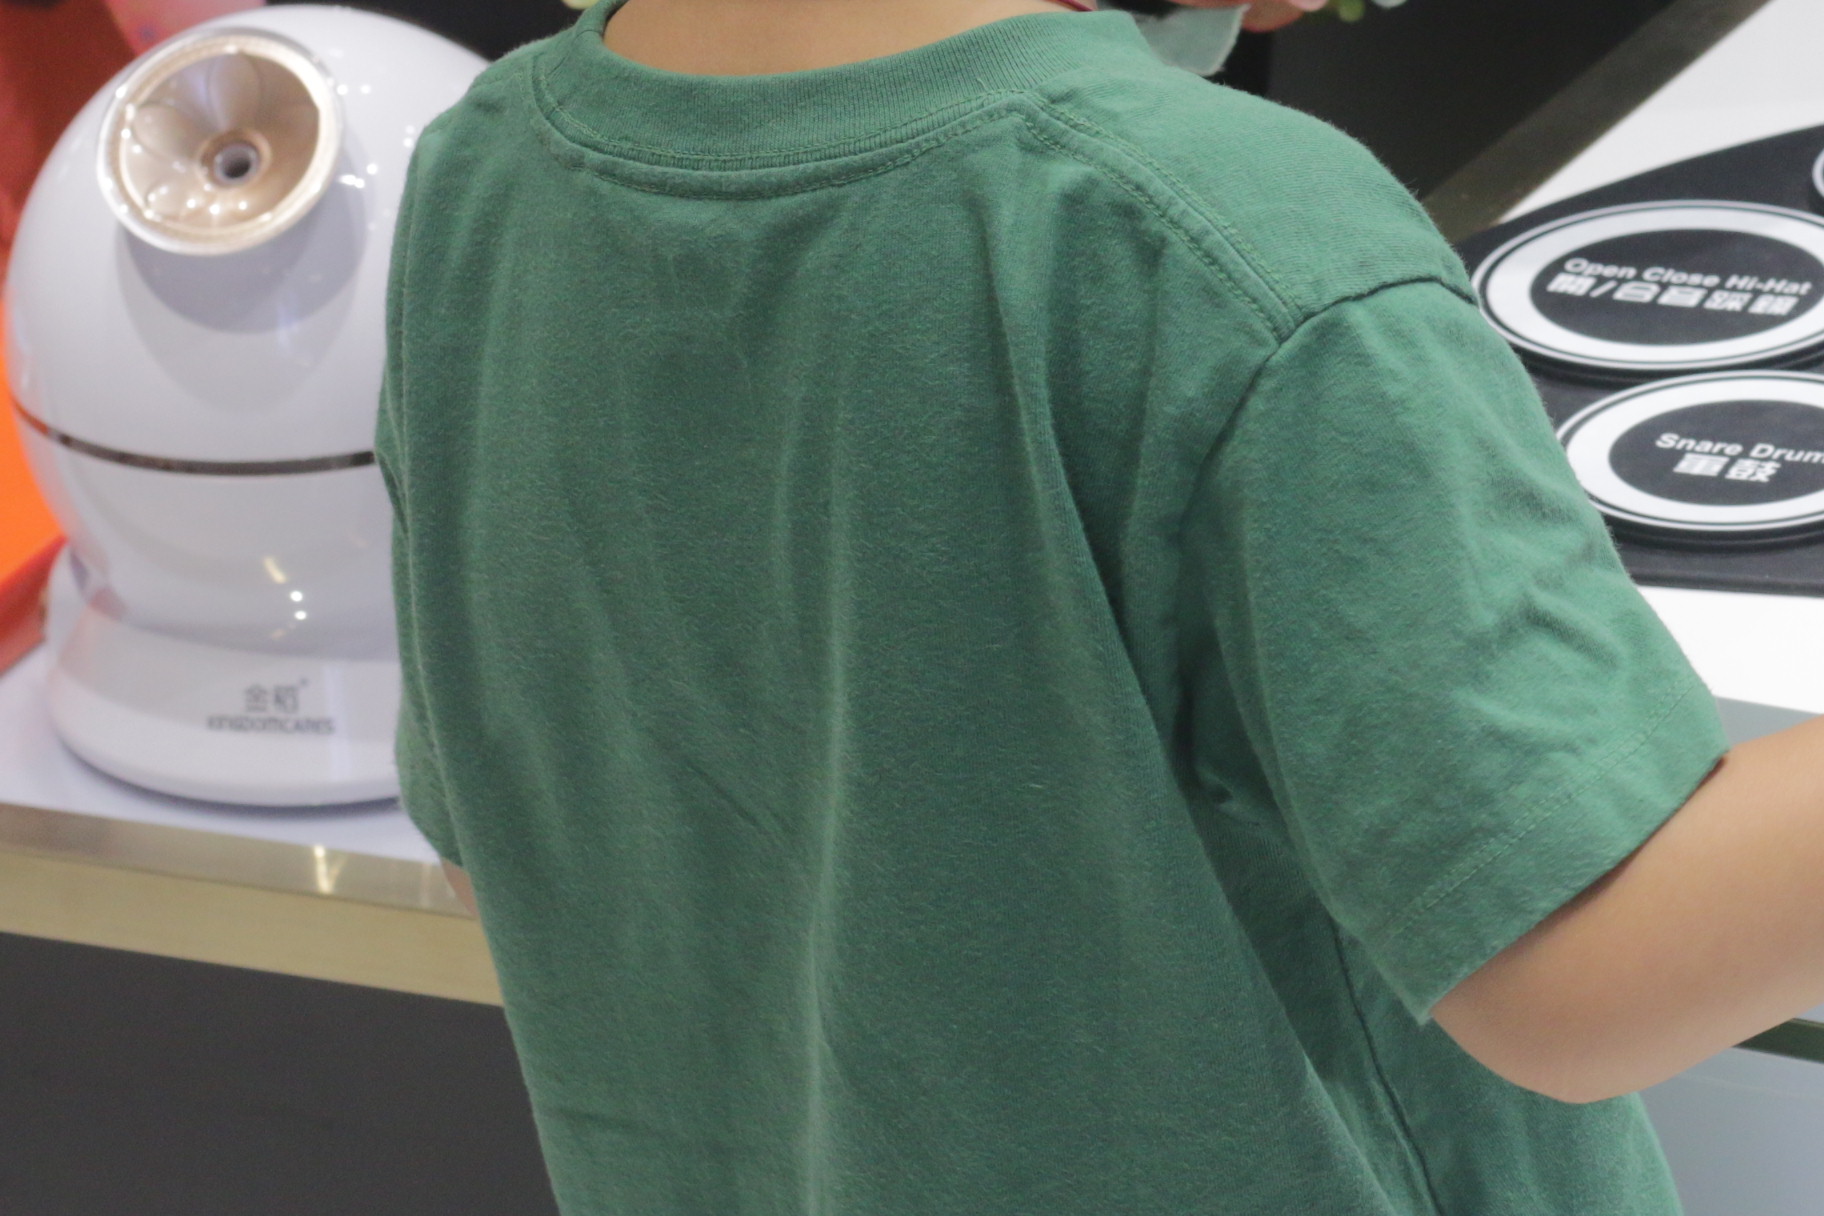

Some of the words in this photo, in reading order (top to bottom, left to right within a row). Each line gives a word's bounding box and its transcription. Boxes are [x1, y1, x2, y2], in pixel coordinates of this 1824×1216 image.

[1564, 257, 1637, 280] Open
[1642, 266, 1721, 287] Close
[1724, 273, 1812, 295] Hi-Hat
[1655, 432, 1744, 456] Snare
